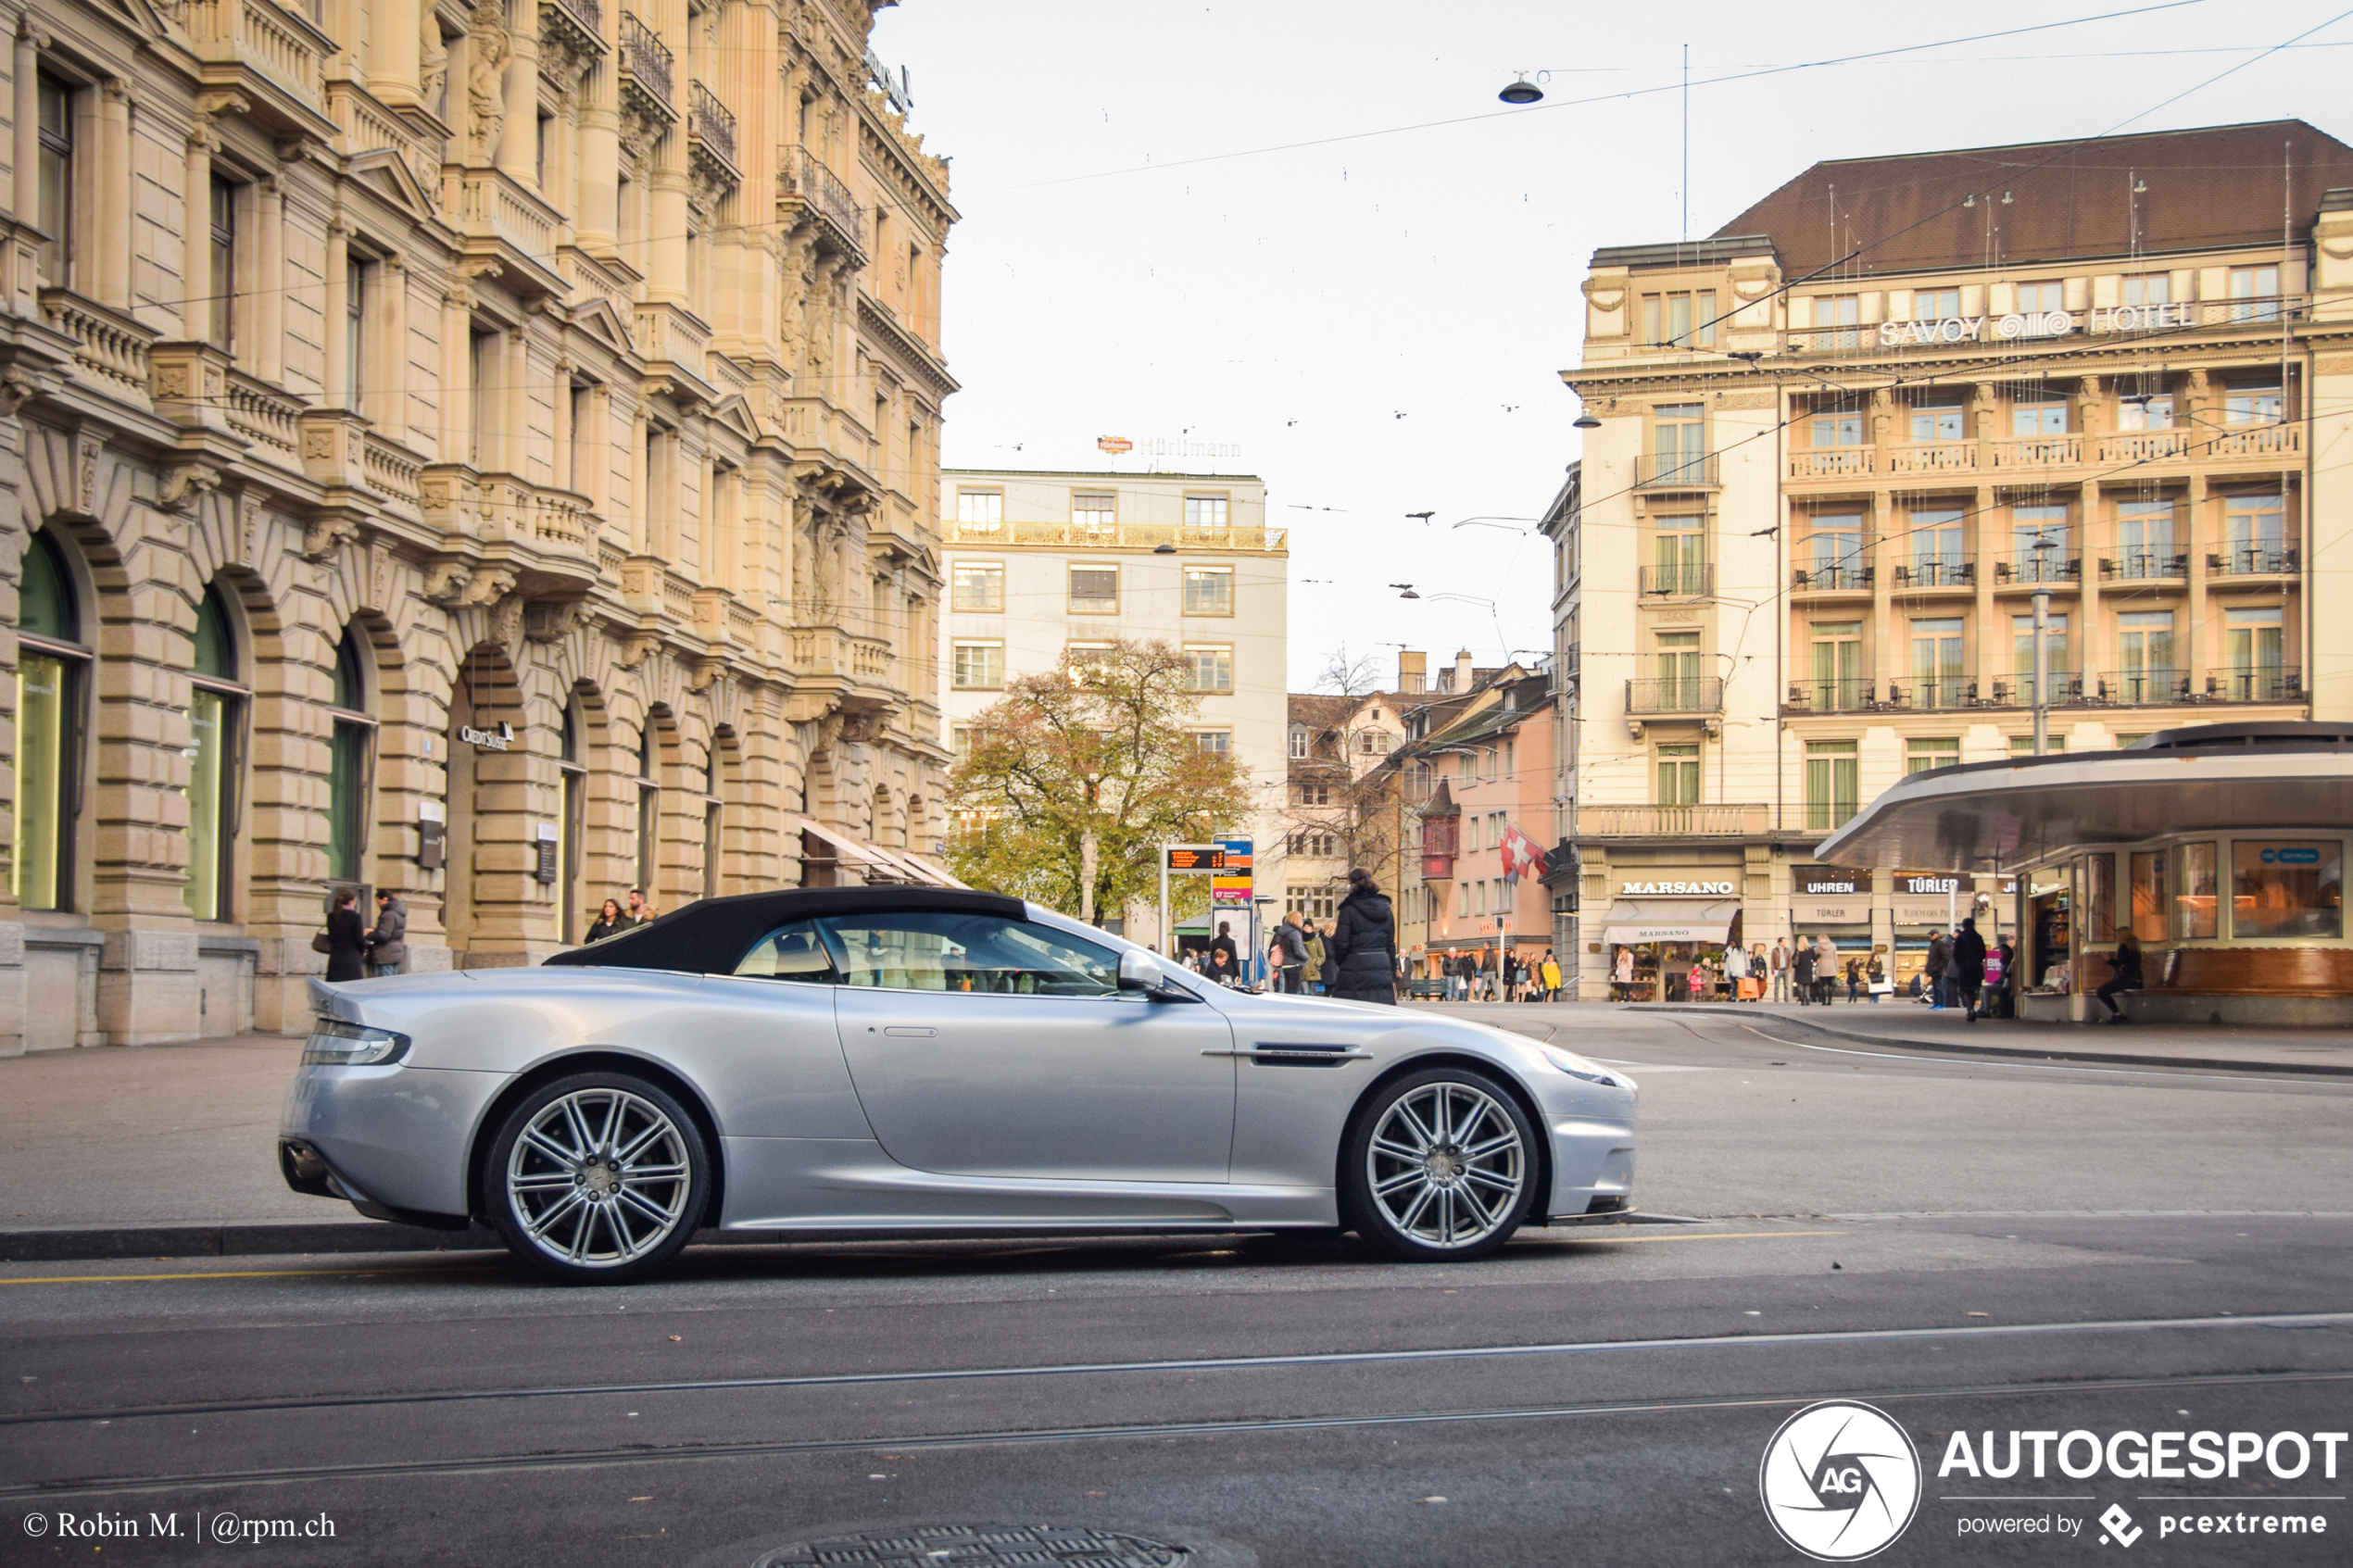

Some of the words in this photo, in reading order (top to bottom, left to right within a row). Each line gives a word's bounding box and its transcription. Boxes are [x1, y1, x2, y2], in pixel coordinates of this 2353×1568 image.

[1879, 316, 1986, 346] SAVOY
[2090, 303, 2196, 332] HOTEL
[1140, 437, 1241, 457] Hürlimann
[1622, 881, 1734, 895] MARSANO
[1806, 882, 1855, 894] UHREN
[1816, 908, 1845, 918] TÜRLER
[1639, 929, 1689, 937] MARSANO
